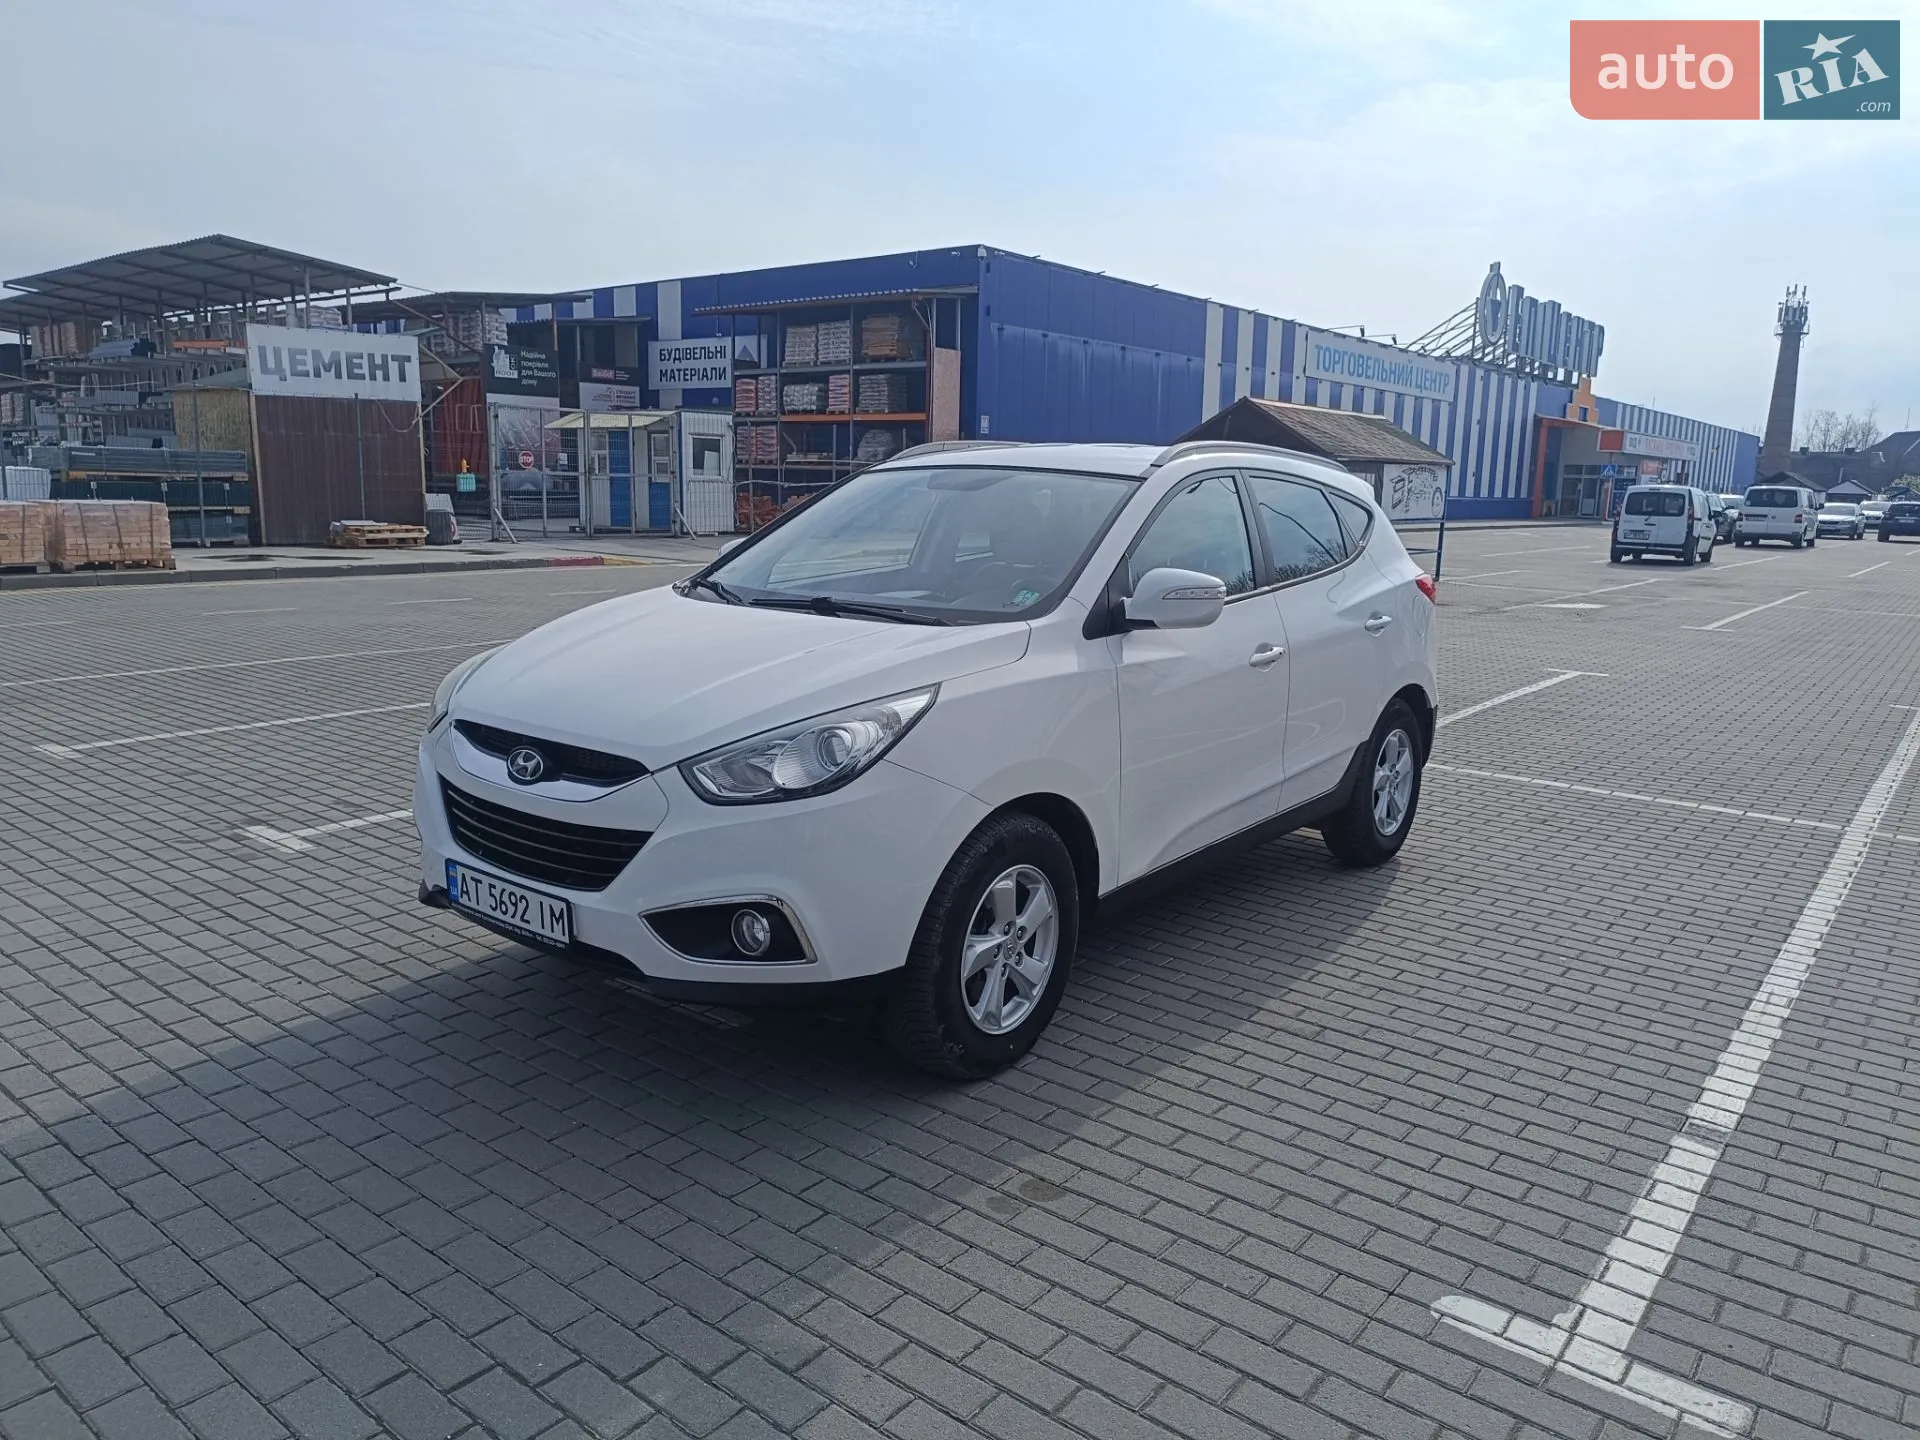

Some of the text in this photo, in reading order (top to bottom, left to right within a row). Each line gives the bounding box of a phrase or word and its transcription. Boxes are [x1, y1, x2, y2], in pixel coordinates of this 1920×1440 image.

[520, 350, 546, 359] Надійна
[659, 345, 727, 363] БУДІВЕЛЬНІ
[258, 345, 412, 382] ЦЕМЕНТ
[1315, 343, 1451, 395] ТОРГОВЕЛЬНИЙ ЦЕНТР
[533, 369, 557, 378] Вашого
[659, 367, 727, 382] МАТЕРІАЛИ
[521, 379, 538, 387] дому
[460, 873, 483, 906] AT
[488, 883, 531, 925] 5692
[539, 901, 566, 937] IM
